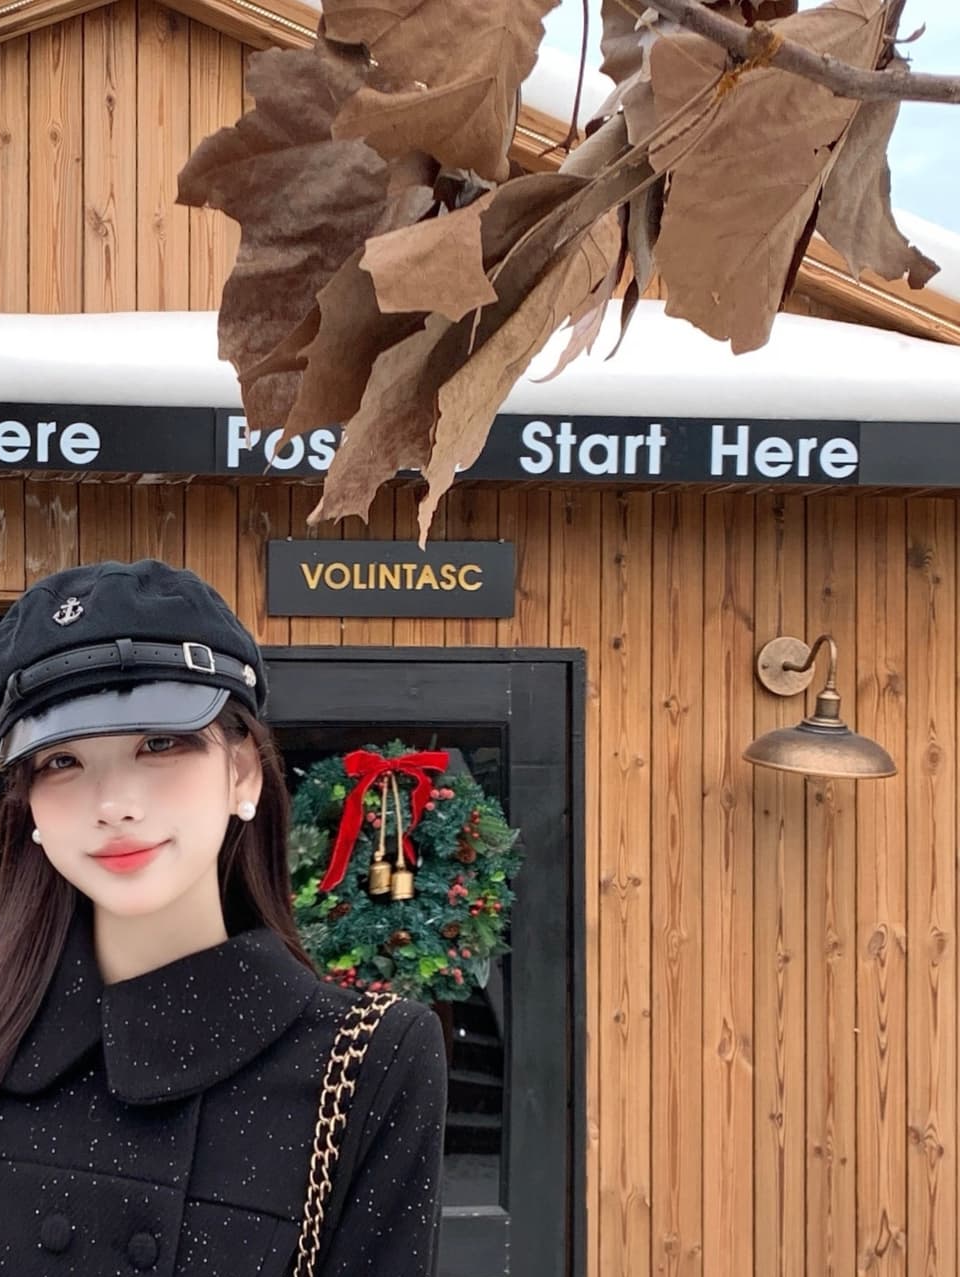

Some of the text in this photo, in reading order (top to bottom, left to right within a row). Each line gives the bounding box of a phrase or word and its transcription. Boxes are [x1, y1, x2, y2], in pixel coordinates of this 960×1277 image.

[519, 420, 667, 475] Start
[710, 425, 859, 479] Here
[301, 562, 484, 592] VOLINTASC
